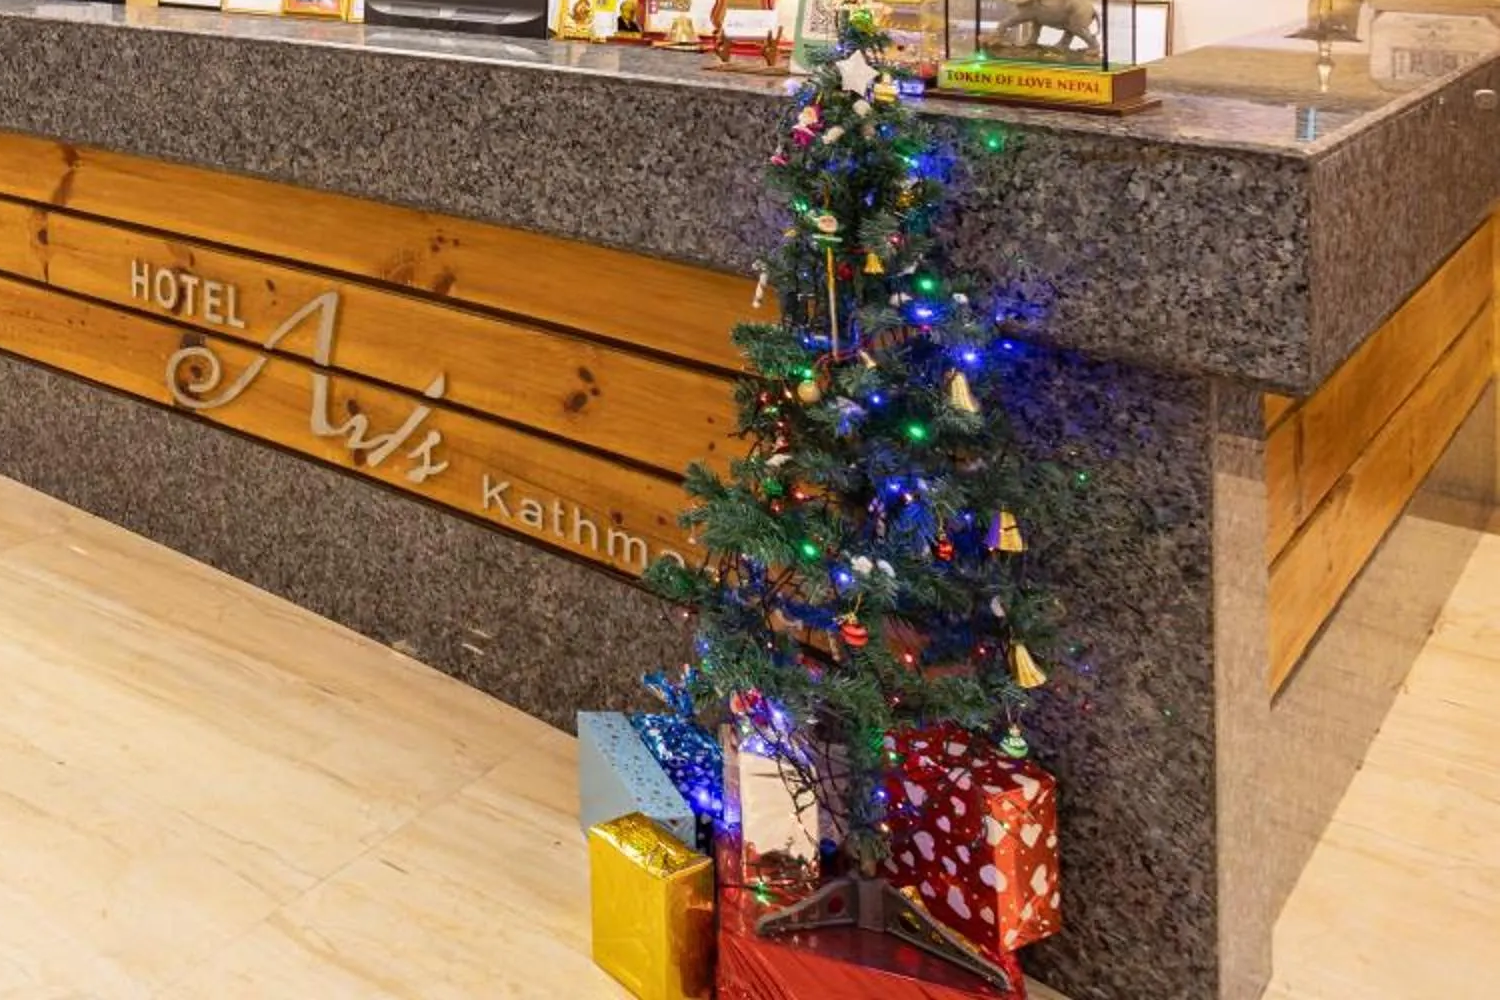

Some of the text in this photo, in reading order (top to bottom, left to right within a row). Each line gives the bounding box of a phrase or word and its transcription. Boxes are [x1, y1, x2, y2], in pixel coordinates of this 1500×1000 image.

[946, 70, 991, 84] TOKEN
[996, 75, 1014, 85] OF
[1017, 75, 1053, 89] LOVE
[131, 259, 245, 329] HOTEL
